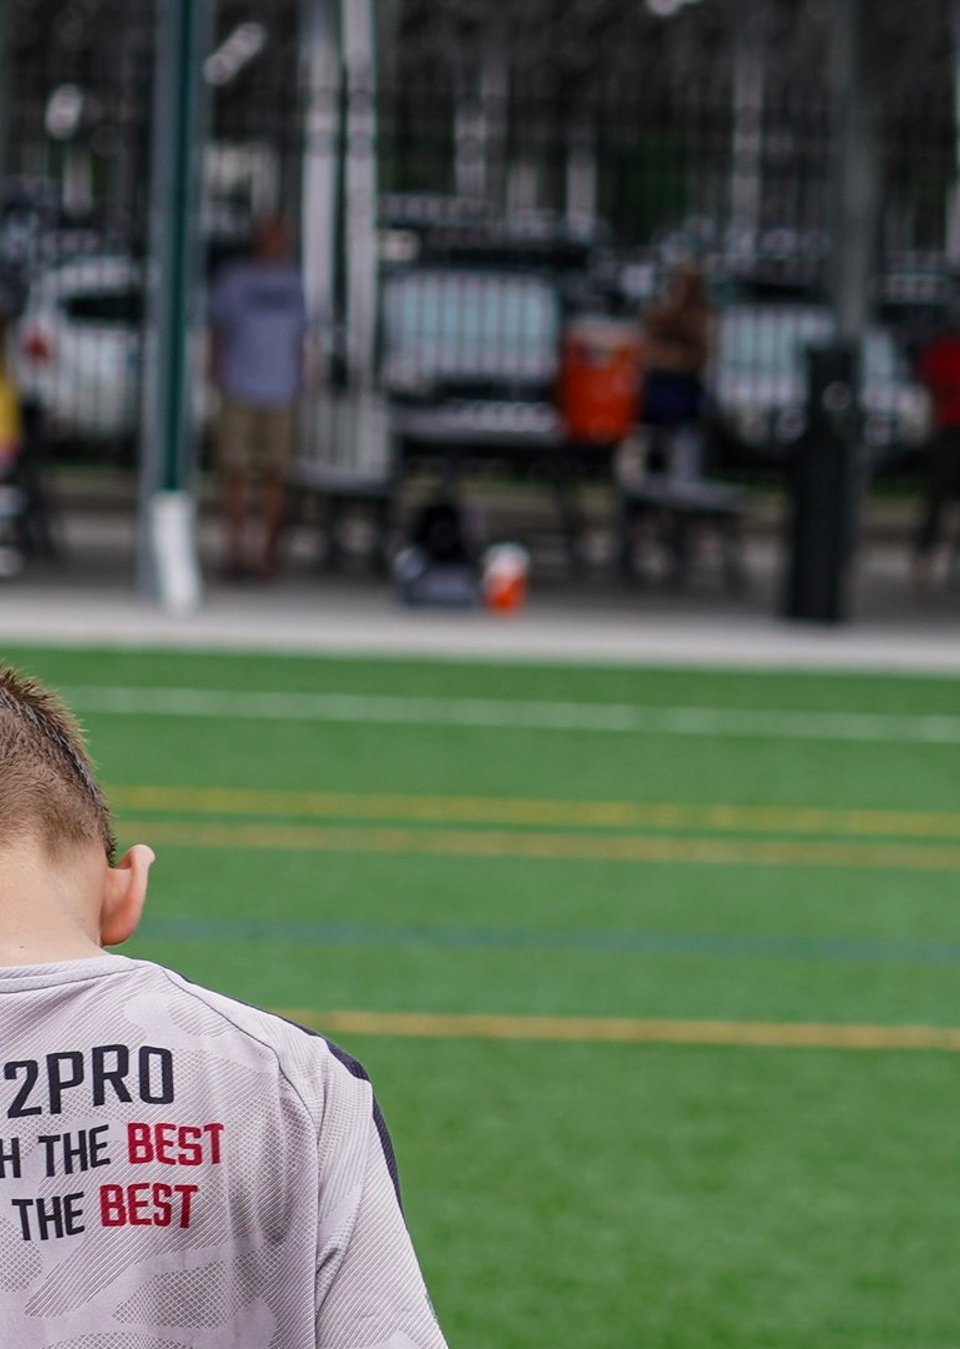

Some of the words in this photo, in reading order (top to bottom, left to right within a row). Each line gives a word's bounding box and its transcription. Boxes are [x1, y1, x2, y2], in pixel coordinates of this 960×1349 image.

[38, 1124, 111, 1177] THE
[126, 1122, 224, 1166] BEST
[11, 1191, 85, 1241] THE
[99, 1183, 198, 1229] BEST
